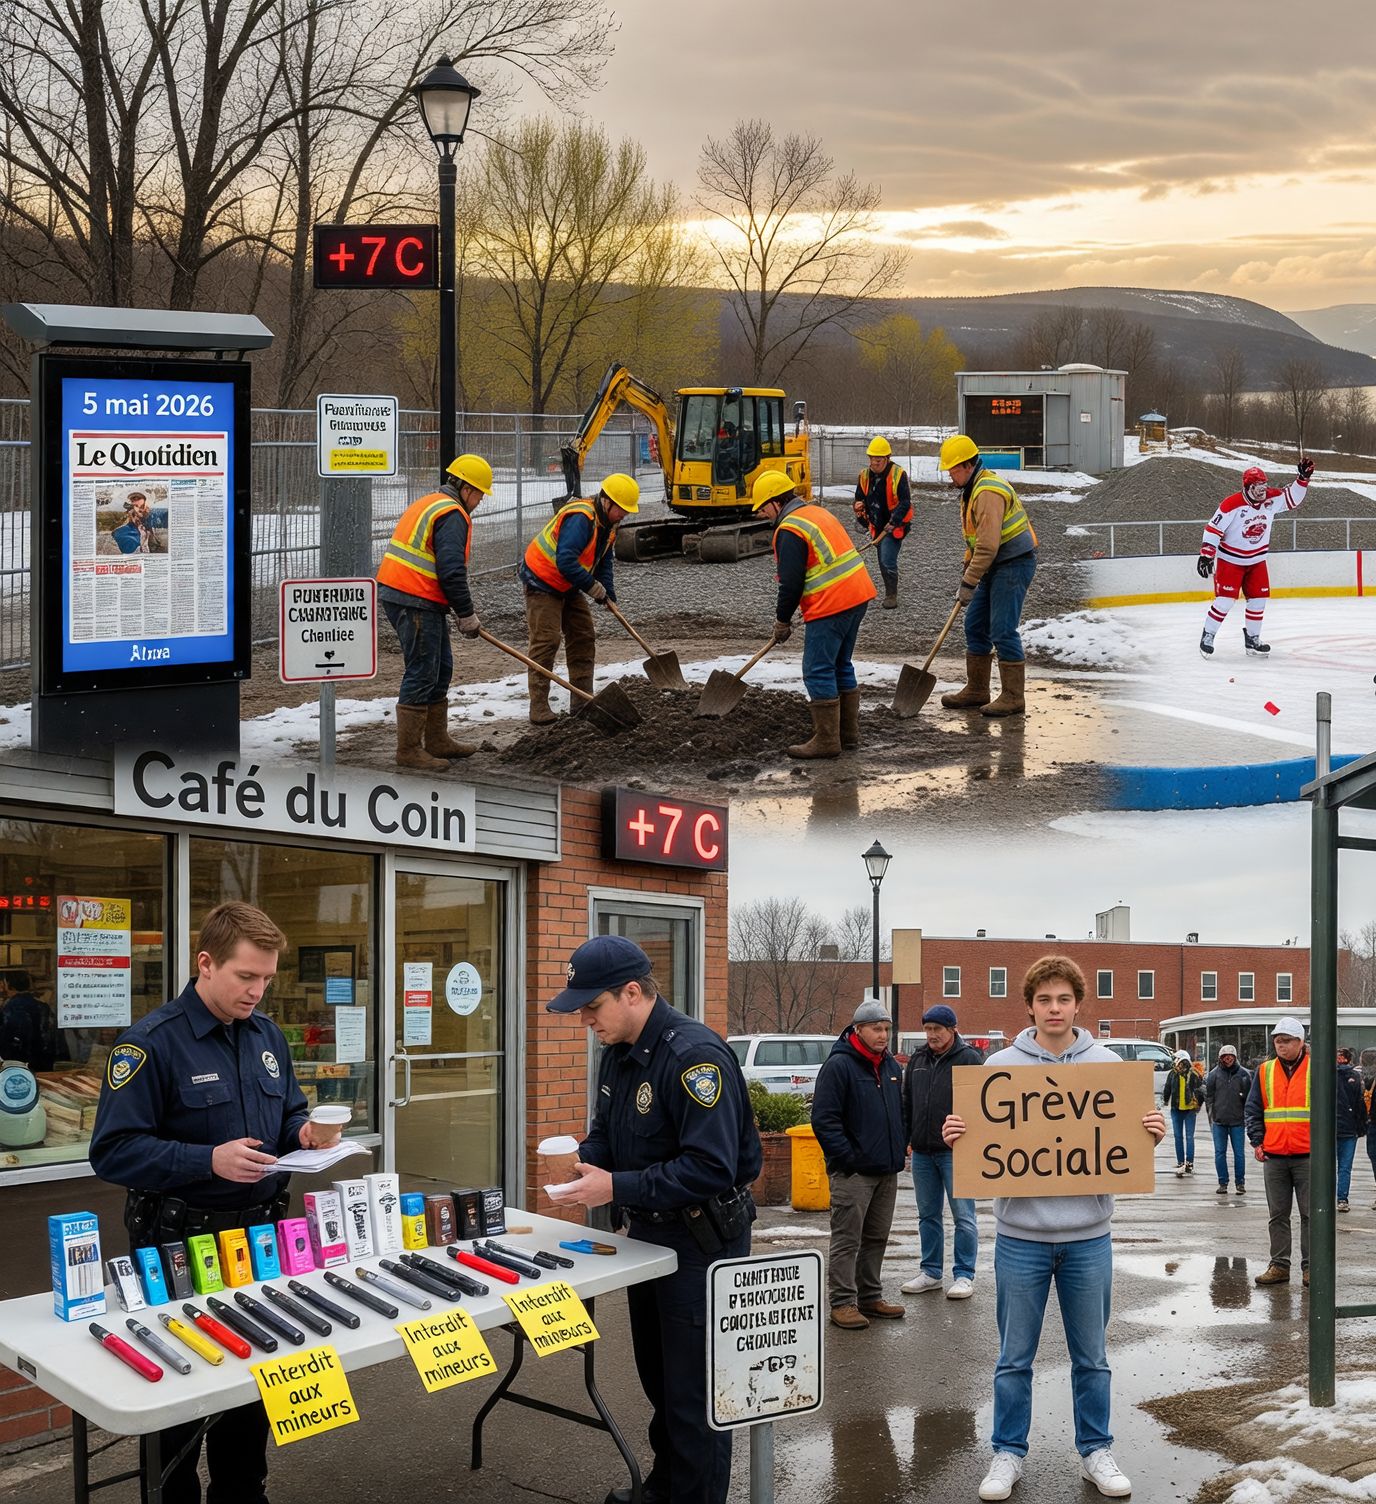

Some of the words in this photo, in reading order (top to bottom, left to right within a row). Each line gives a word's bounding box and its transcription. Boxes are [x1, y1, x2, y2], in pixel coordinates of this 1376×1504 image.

[82, 392, 98, 415] 5
[105, 393, 149, 416] mai
[155, 394, 214, 417] 2026
[76, 442, 107, 468] Le
[109, 442, 218, 472] Quotidien
[132, 750, 265, 818] Café
[286, 773, 347, 828] du
[367, 784, 466, 843] Coin
[980, 1071, 1116, 1130] Grève
[511, 1283, 571, 1313] Interdit
[404, 1312, 468, 1344] Interdit
[259, 1350, 334, 1388] Interdit
[424, 1353, 491, 1385] mineurs
[289, 1383, 323, 1405] aux
[276, 1399, 351, 1436] mineurs
